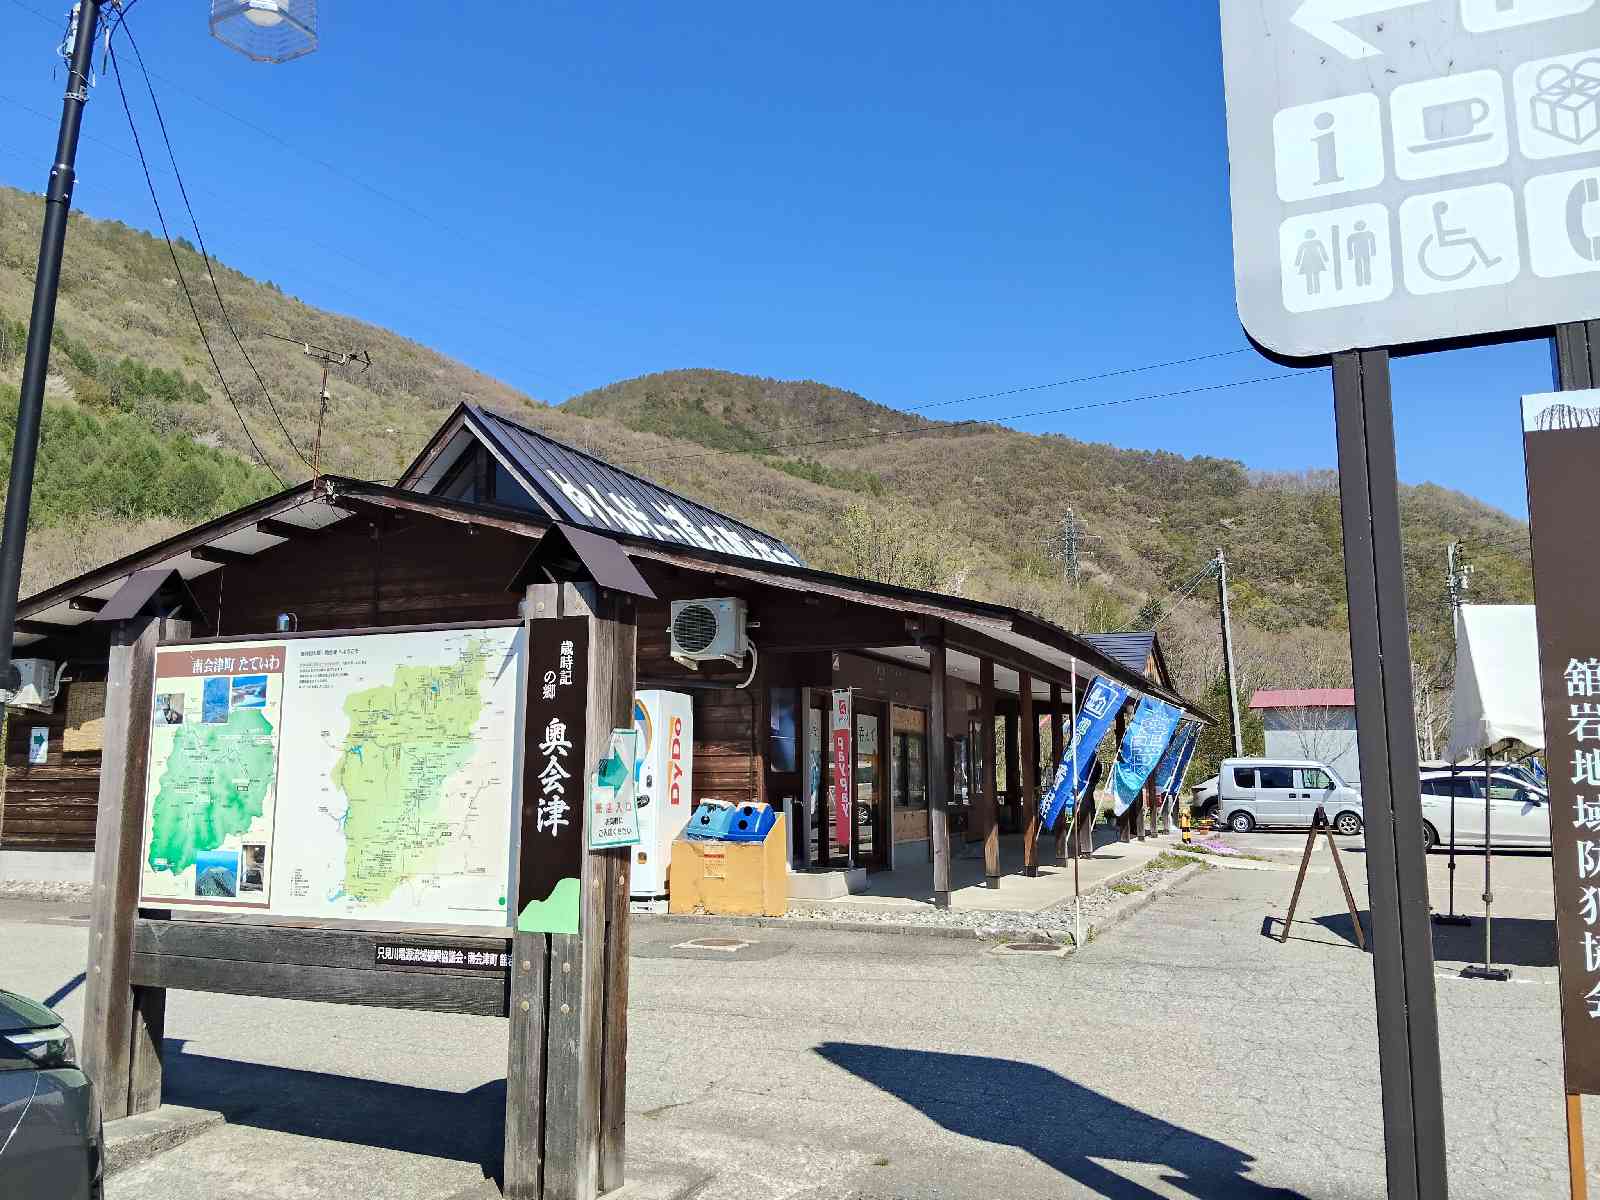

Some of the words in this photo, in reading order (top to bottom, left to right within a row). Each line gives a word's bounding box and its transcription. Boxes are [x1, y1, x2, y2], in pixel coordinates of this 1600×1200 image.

[192, 655, 234, 674] 南会津町
[239, 654, 280, 672] たていわ
[559, 640, 574, 685] 歳時記
[543, 670, 557, 699] の郷
[536, 717, 573, 837] 奥会津
